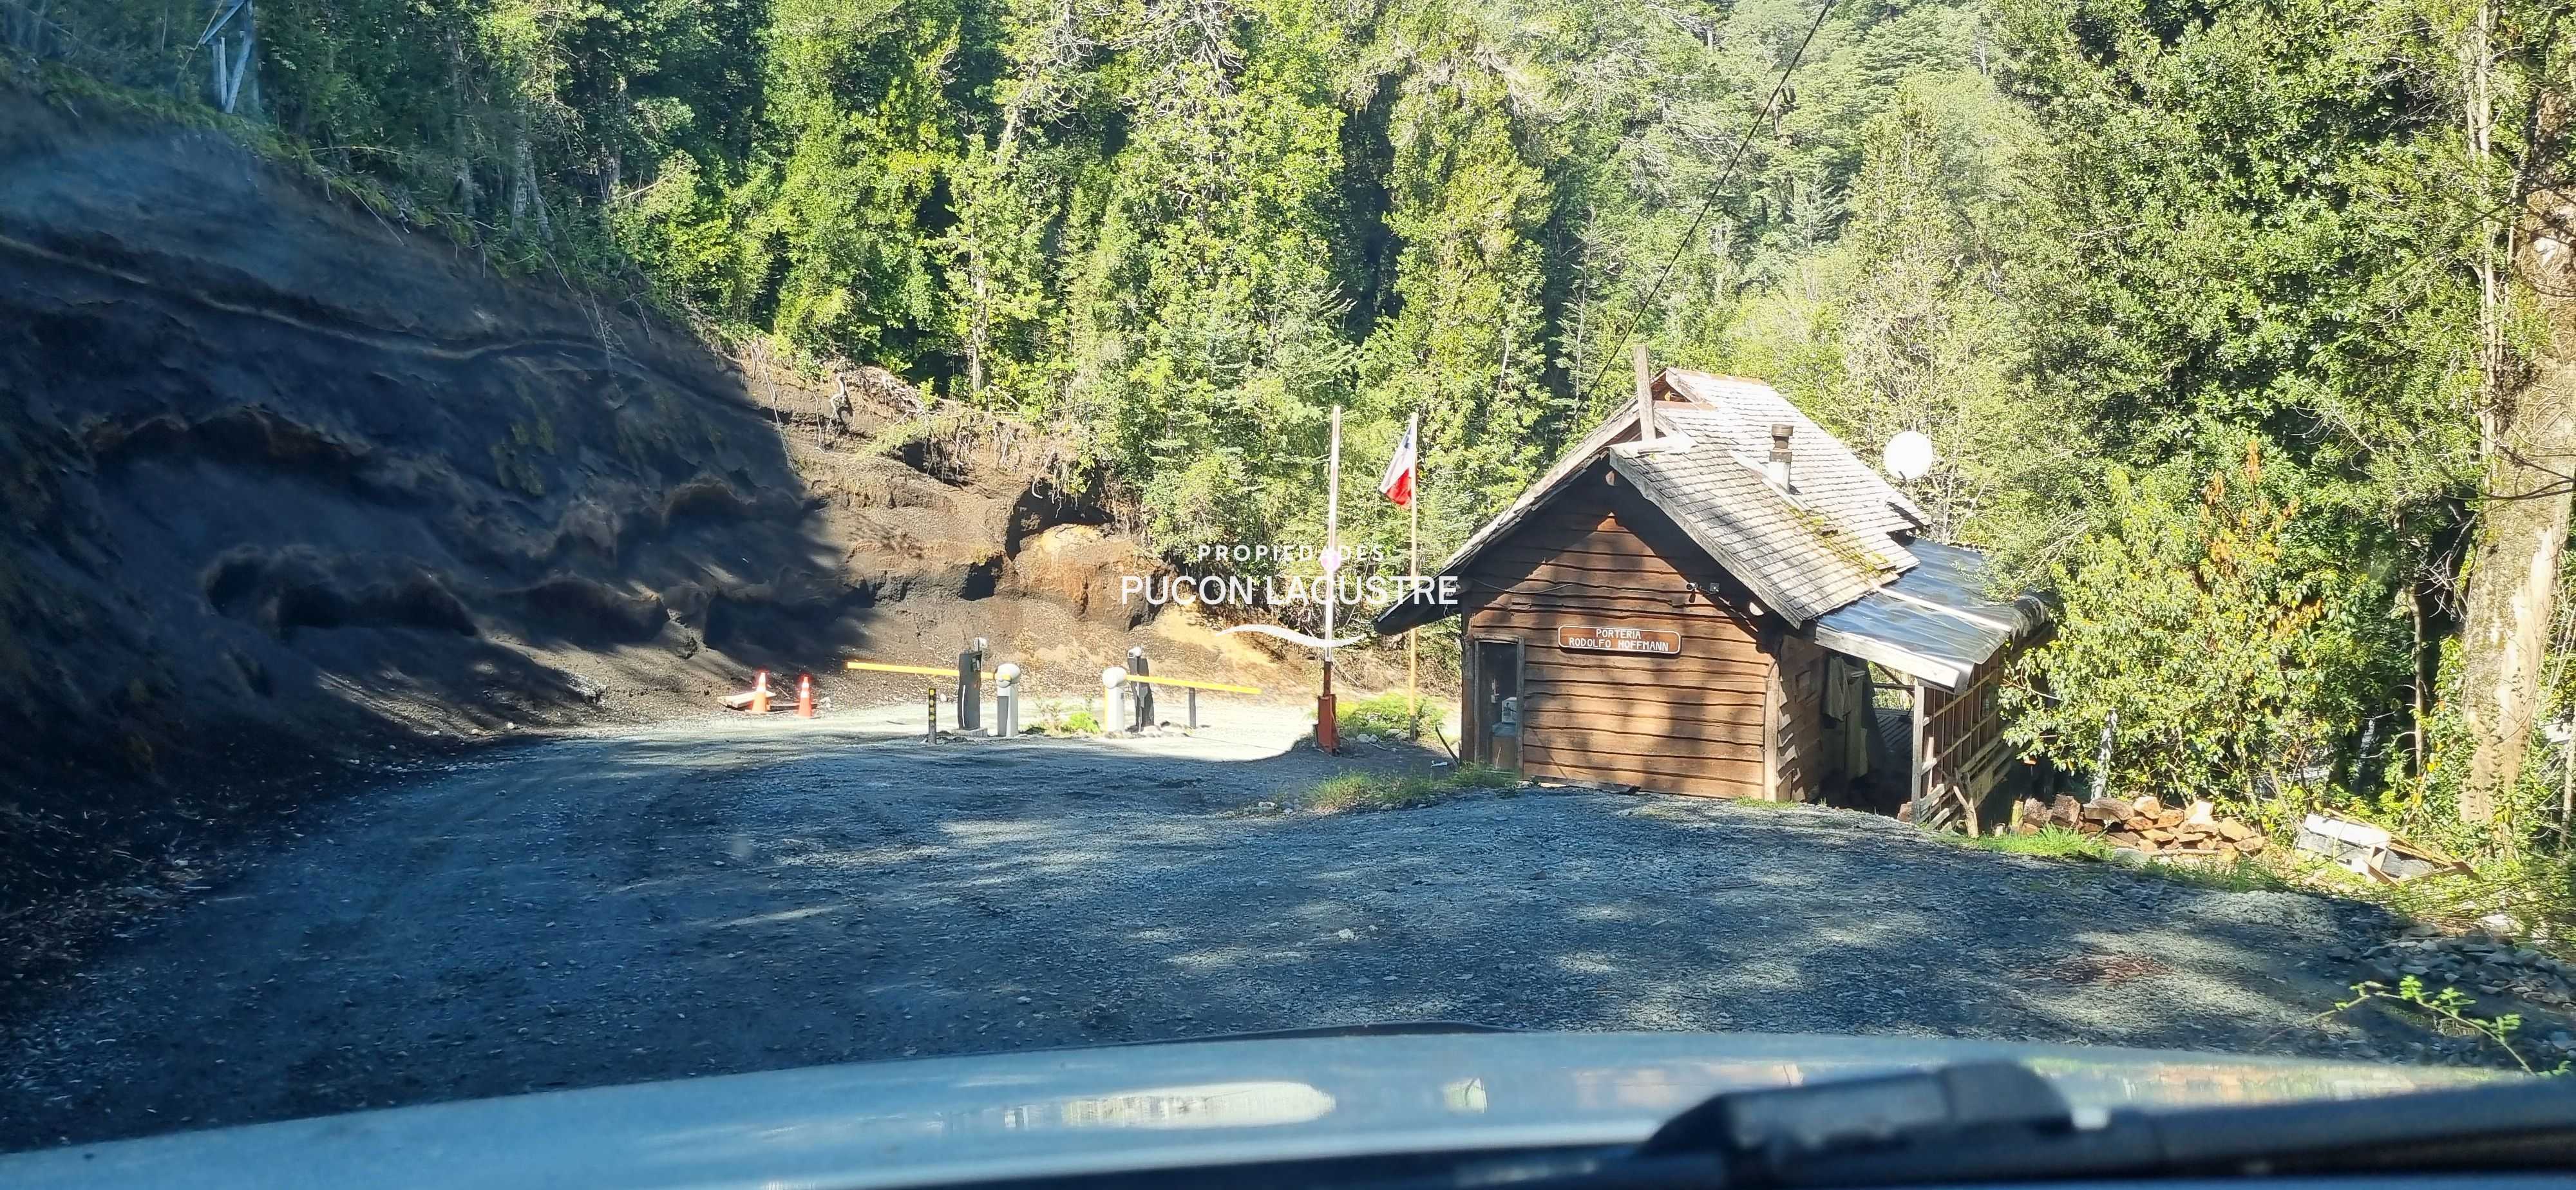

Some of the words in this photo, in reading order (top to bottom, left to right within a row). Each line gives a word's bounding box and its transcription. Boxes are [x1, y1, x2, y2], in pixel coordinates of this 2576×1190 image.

[1596, 628, 1642, 639] PORTERIA
[1569, 637, 1611, 648] RODOLFO
[1618, 639, 1669, 652] HOFFMANN
